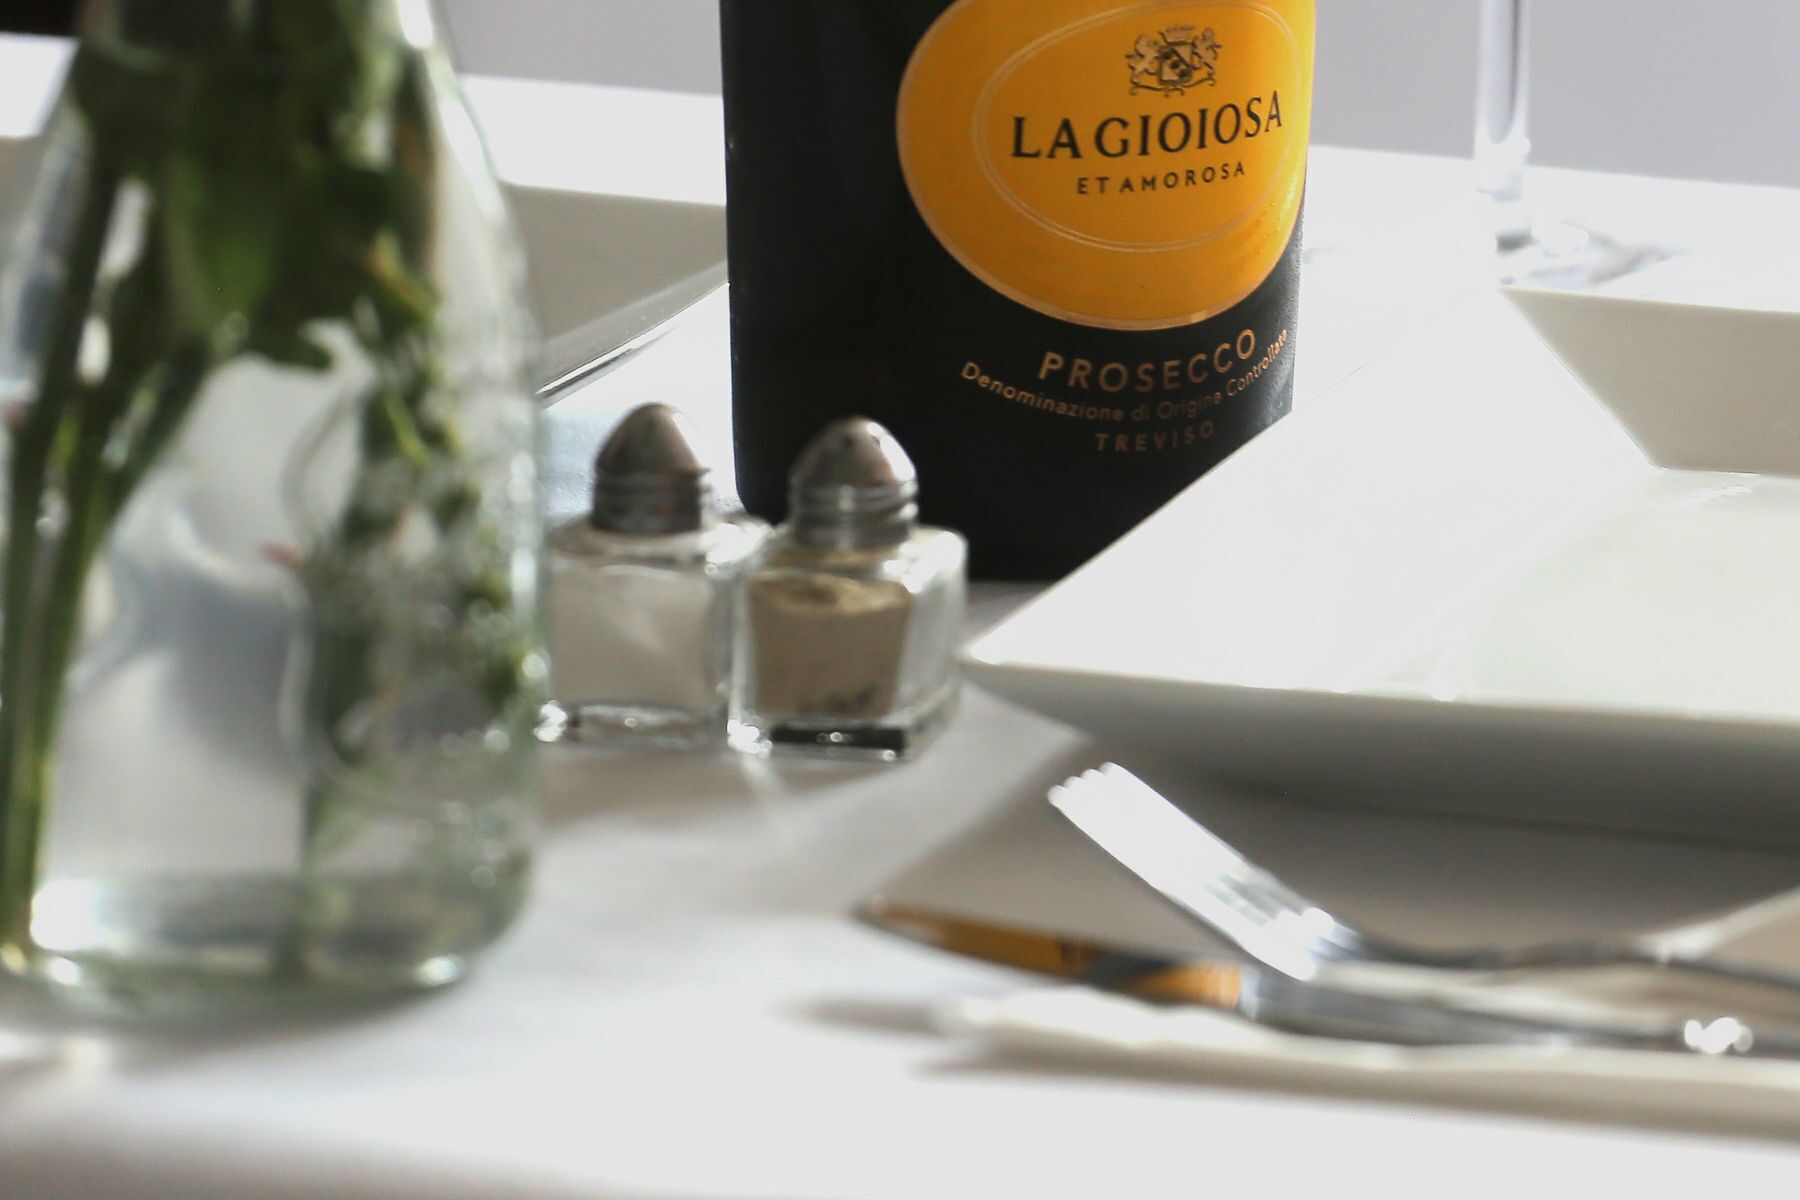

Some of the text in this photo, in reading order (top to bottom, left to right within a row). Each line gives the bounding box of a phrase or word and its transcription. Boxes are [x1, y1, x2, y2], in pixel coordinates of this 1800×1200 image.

[1010, 90, 1283, 159] LA GIOIOSA
[1076, 161, 1247, 196] ET AMOROSA
[1037, 328, 1256, 393] PROSECCO
[960, 361, 1124, 422] Denominazione
[1131, 406, 1152, 422] di
[1156, 391, 1223, 420] Origine
[1095, 419, 1215, 453] TREVISO
